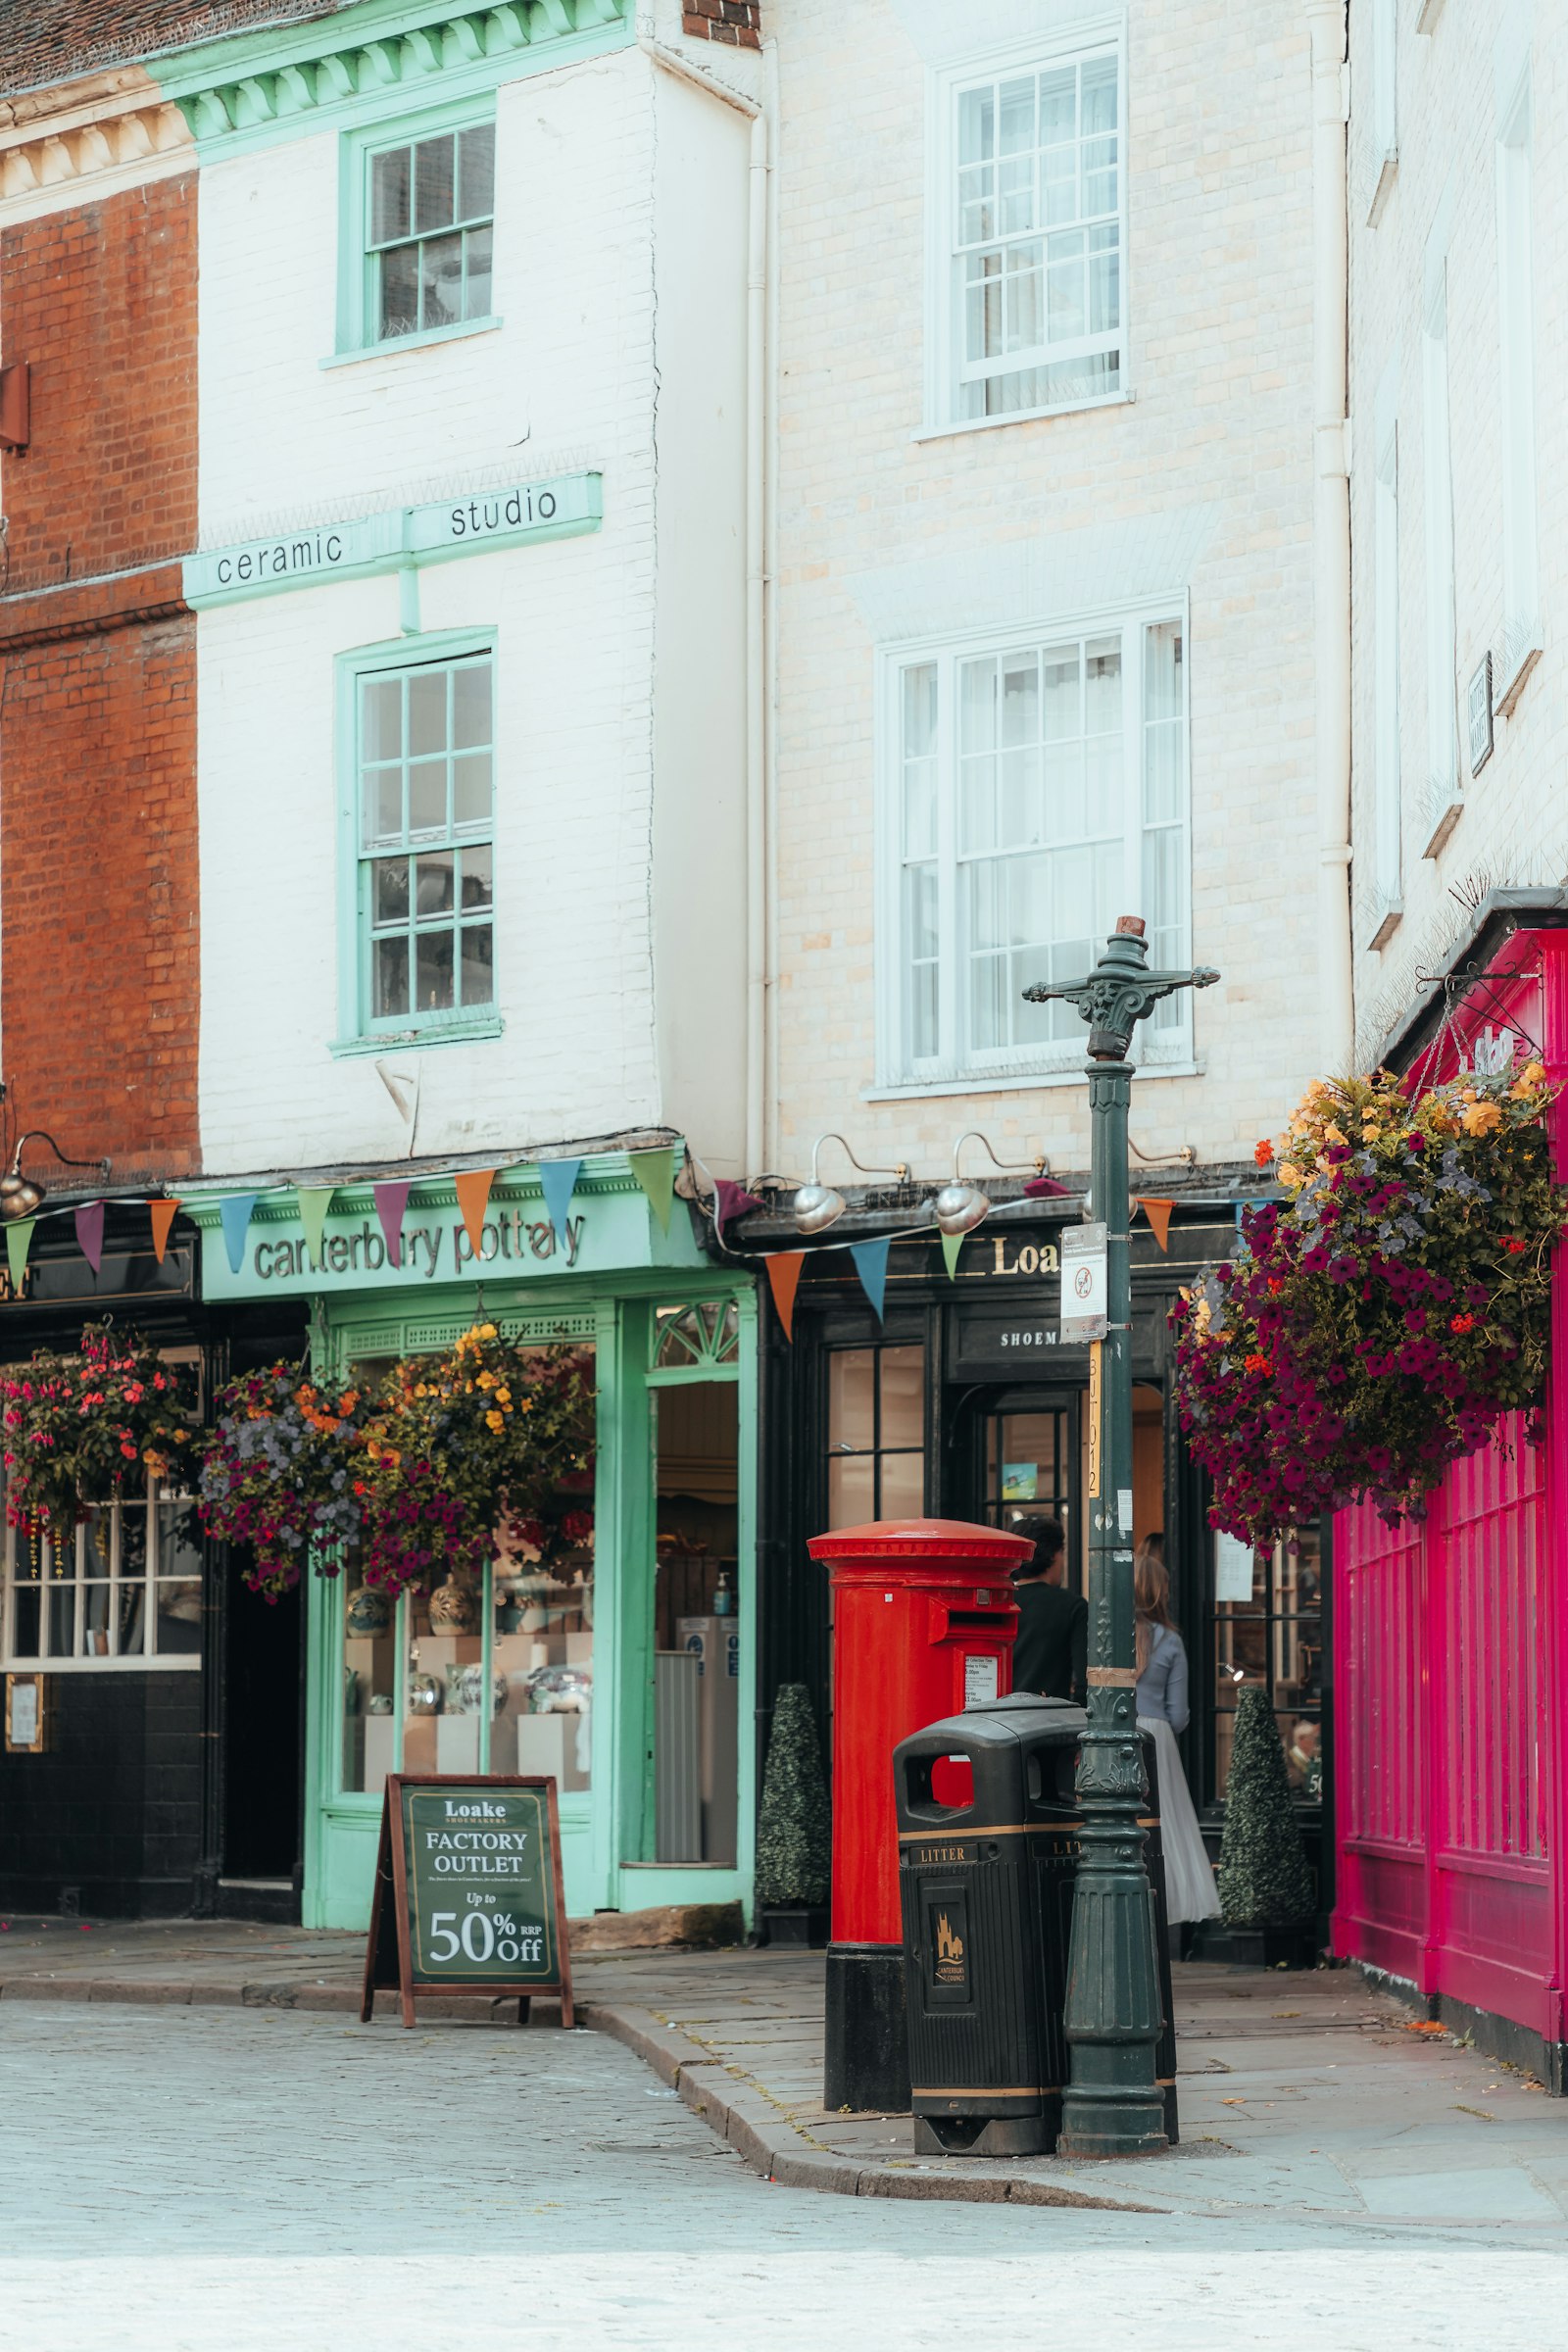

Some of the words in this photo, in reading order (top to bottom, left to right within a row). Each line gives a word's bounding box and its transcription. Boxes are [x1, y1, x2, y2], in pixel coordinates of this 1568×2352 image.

[218, 533, 342, 583] ceramic
[452, 488, 557, 536] studio
[992, 1236, 1061, 1275] Loa
[1001, 1332, 1061, 1347] SHOEM
[444, 1800, 507, 1817] Loake
[425, 1832, 527, 1850] FACTORY
[921, 1847, 965, 1862] LITTER
[1054, 1840, 1081, 1854] LIT
[433, 1855, 522, 1873] OUTLET
[466, 1892, 483, 1907] Up
[484, 1893, 497, 1904] to
[429, 1912, 516, 1962] 50%
[520, 1926, 542, 1936] RRP
[497, 1938, 543, 1962] Off
